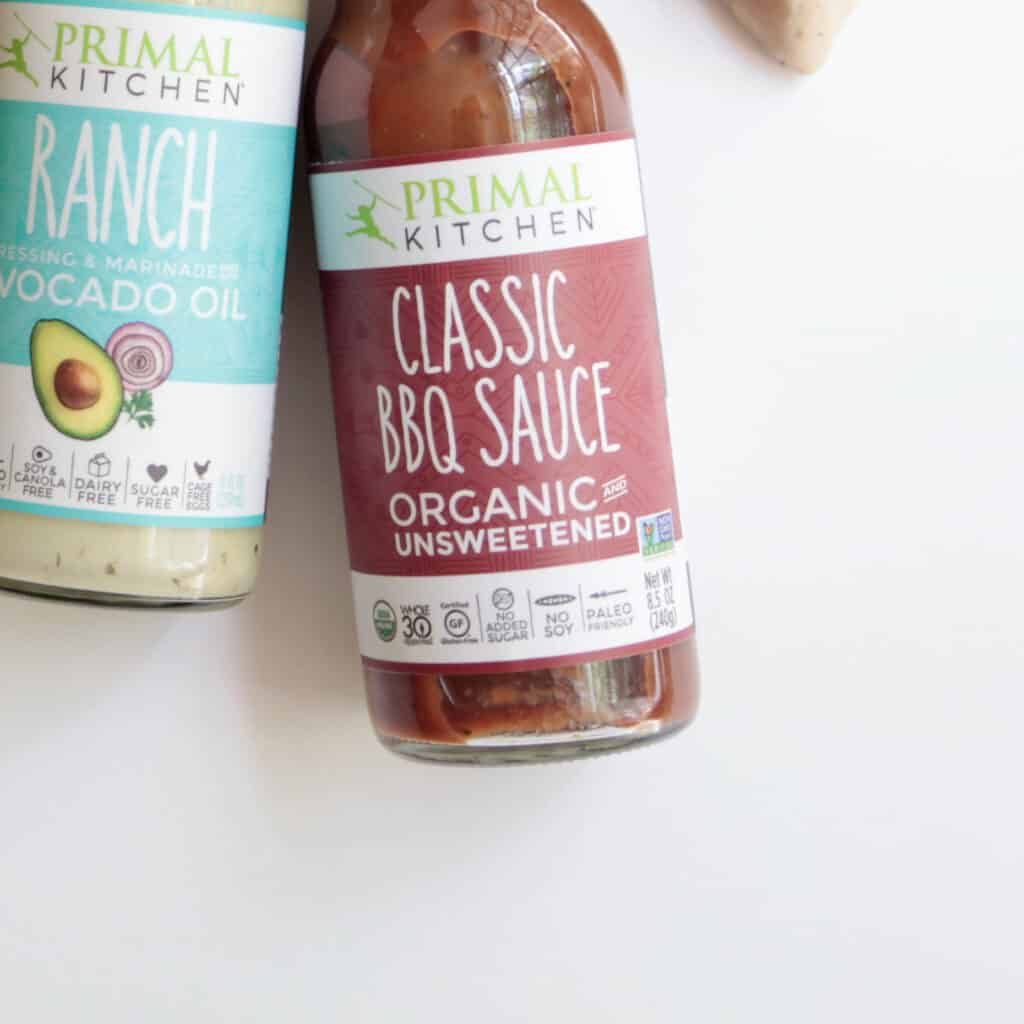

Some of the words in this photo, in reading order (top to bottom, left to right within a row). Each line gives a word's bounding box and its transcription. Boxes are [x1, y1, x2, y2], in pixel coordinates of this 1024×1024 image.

[51, 21, 241, 78] PRIMAL
[51, 66, 242, 106] KITCHEN
[26, 114, 217, 251] RANCH
[400, 162, 593, 221] PRIMAL
[405, 208, 595, 252] KITCHEN
[84, 256, 96, 268] &
[106, 257, 223, 279] MARINADE
[191, 286, 248, 321] OIL
[392, 269, 575, 376] CLASSIC
[376, 383, 465, 475] BBQ
[475, 361, 622, 468] SAUCE
[24, 463, 48, 474] SOY
[14, 472, 66, 488] CANOLA
[76, 478, 122, 493] DAIRY
[23, 485, 53, 498] FREE
[77, 491, 117, 505] FREE
[131, 483, 180, 498] SUGAR
[136, 496, 172, 510] FREE
[389, 476, 598, 527] ORGANIC
[602, 479, 628, 497] AND
[395, 511, 631, 558] UNSWEETENED
[496, 611, 515, 621] NO
[546, 611, 570, 625] NO
[587, 602, 633, 619] PALEO
[402, 615, 432, 639] 30
[486, 620, 529, 632] ADDED
[544, 624, 574, 638] SOY
[588, 617, 634, 632] FRIENDLY
[487, 631, 529, 643] SUGAR
